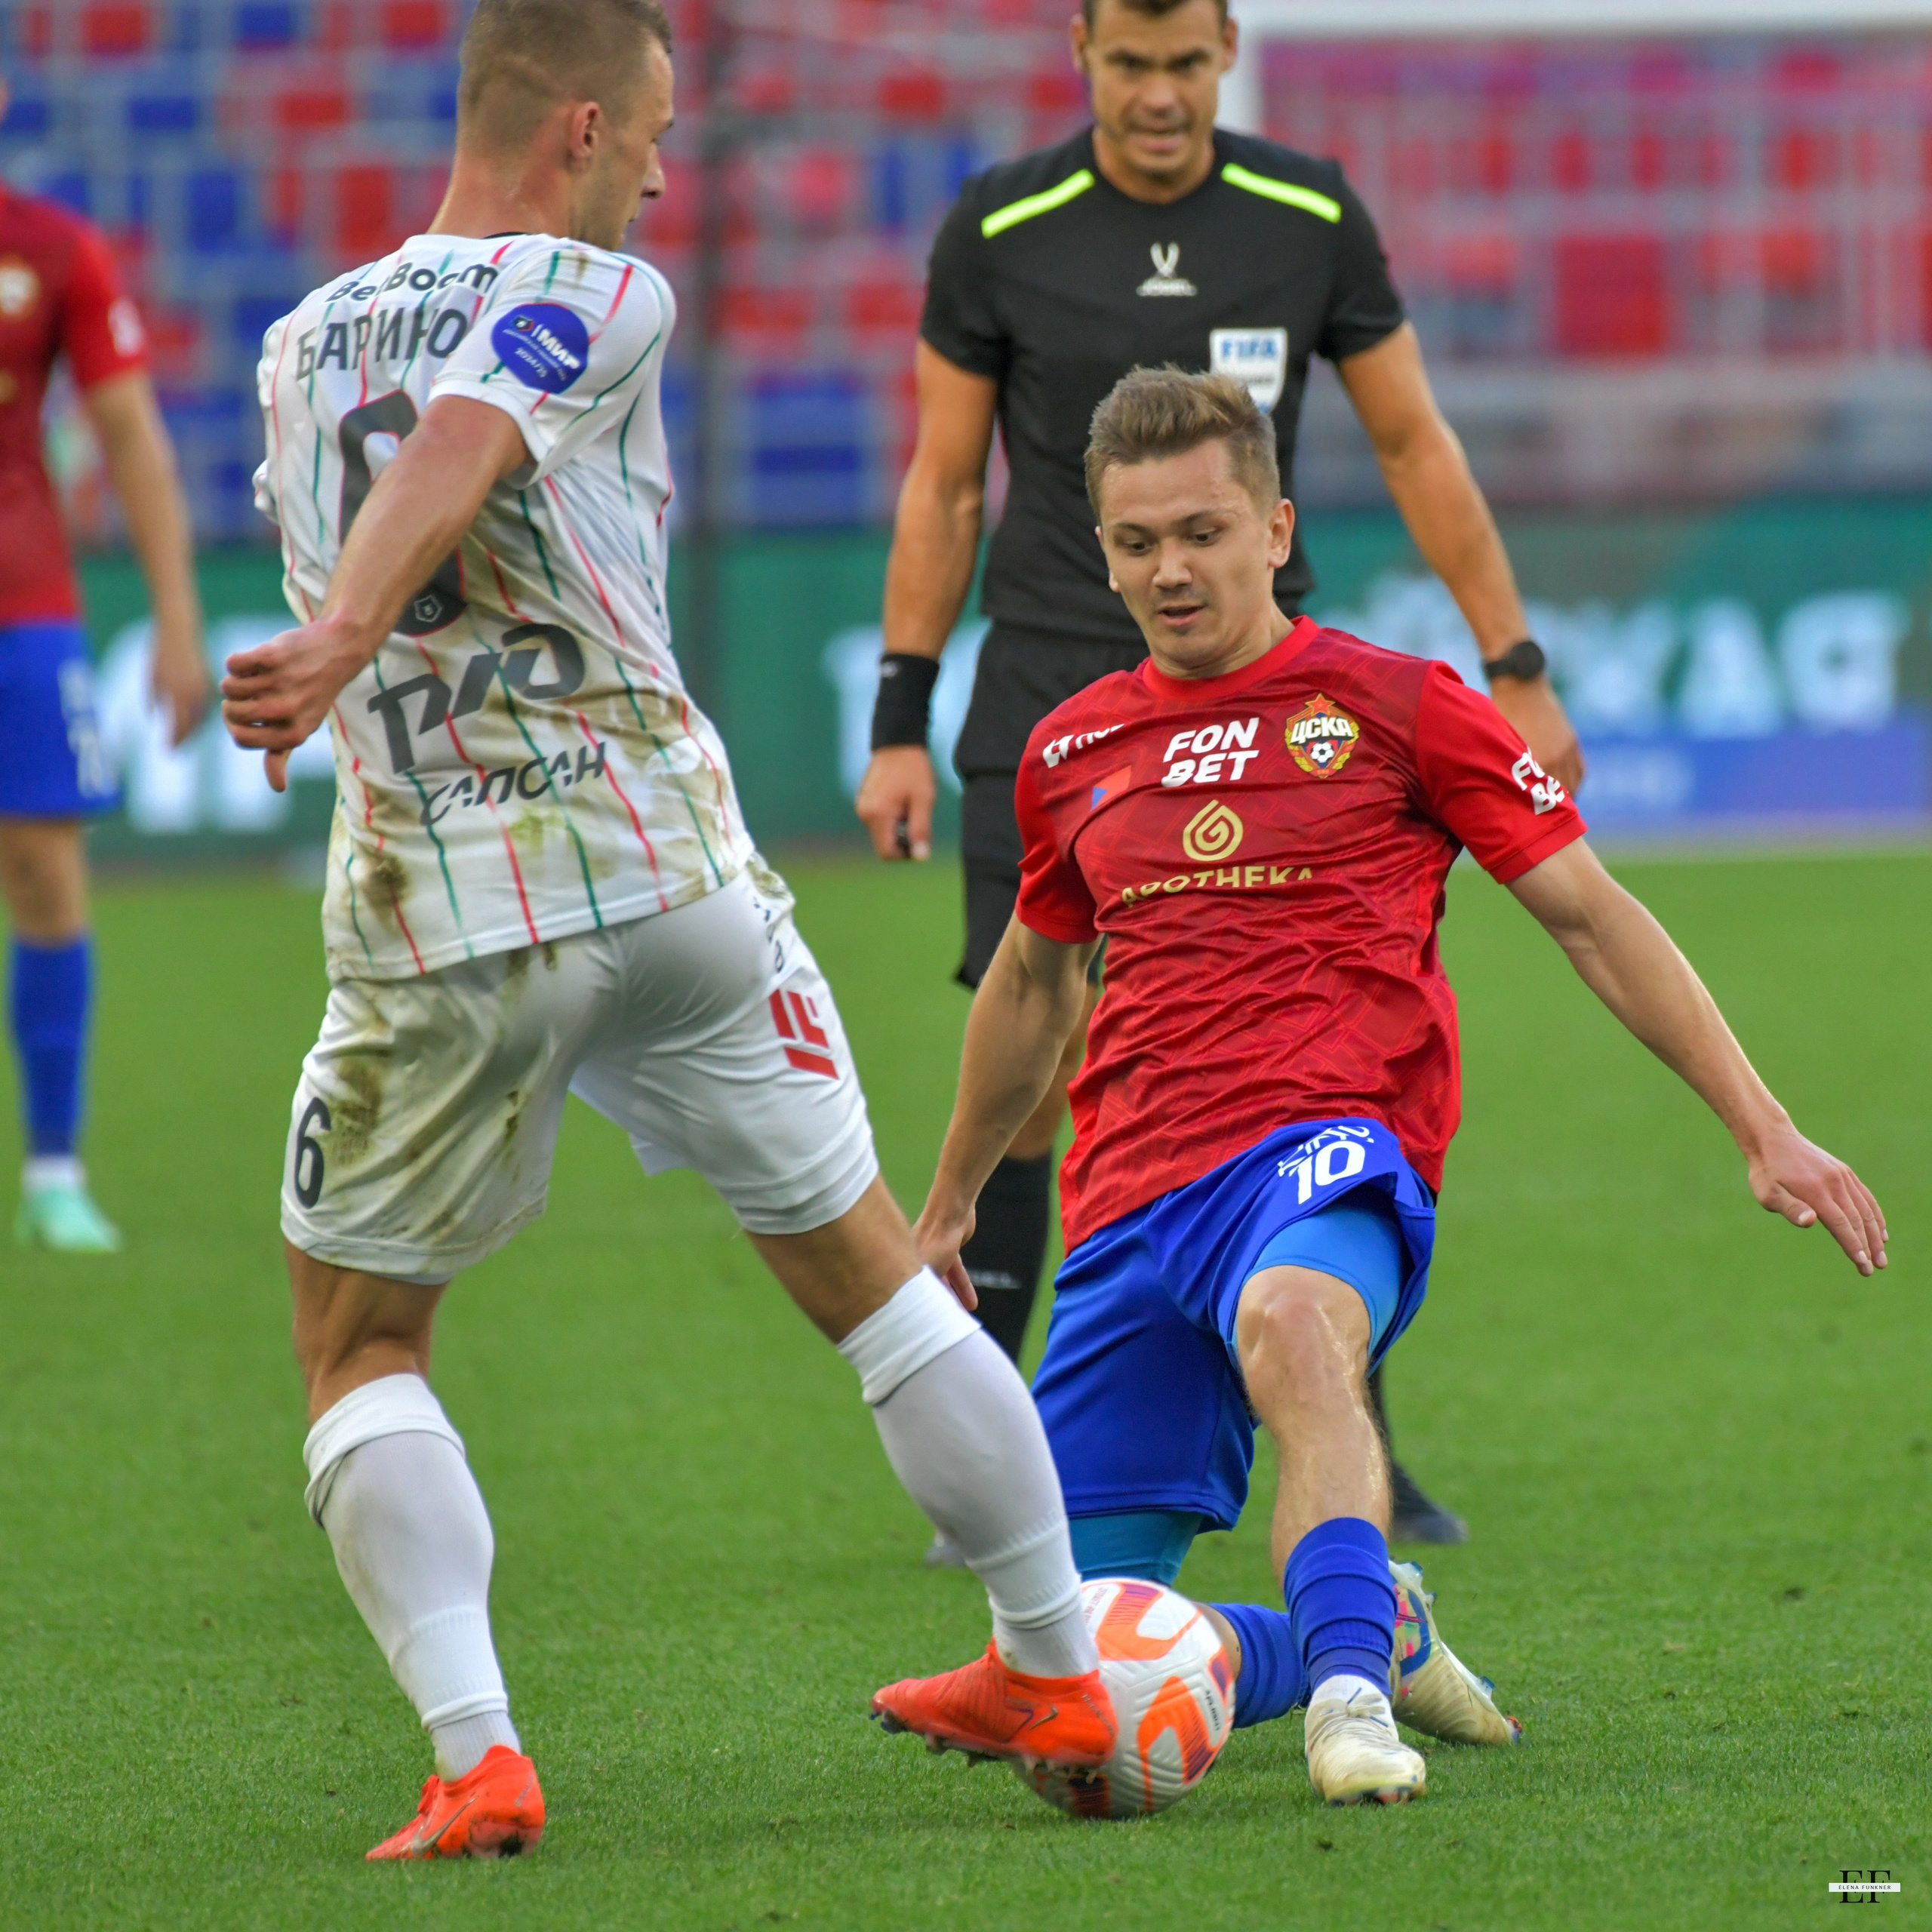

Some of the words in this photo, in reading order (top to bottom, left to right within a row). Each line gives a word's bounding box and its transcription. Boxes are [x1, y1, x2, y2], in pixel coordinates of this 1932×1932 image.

[537, 328, 580, 369] МИР
[1220, 339, 1277, 358] FIFA
[1162, 716, 1260, 764] FON
[1290, 716, 1354, 745] ЦСКА
[420, 742, 606, 826] САПСАН
[1161, 749, 1260, 788] BET
[294, 1097, 331, 1210] 6
[1288, 1140, 1366, 1205] 10
